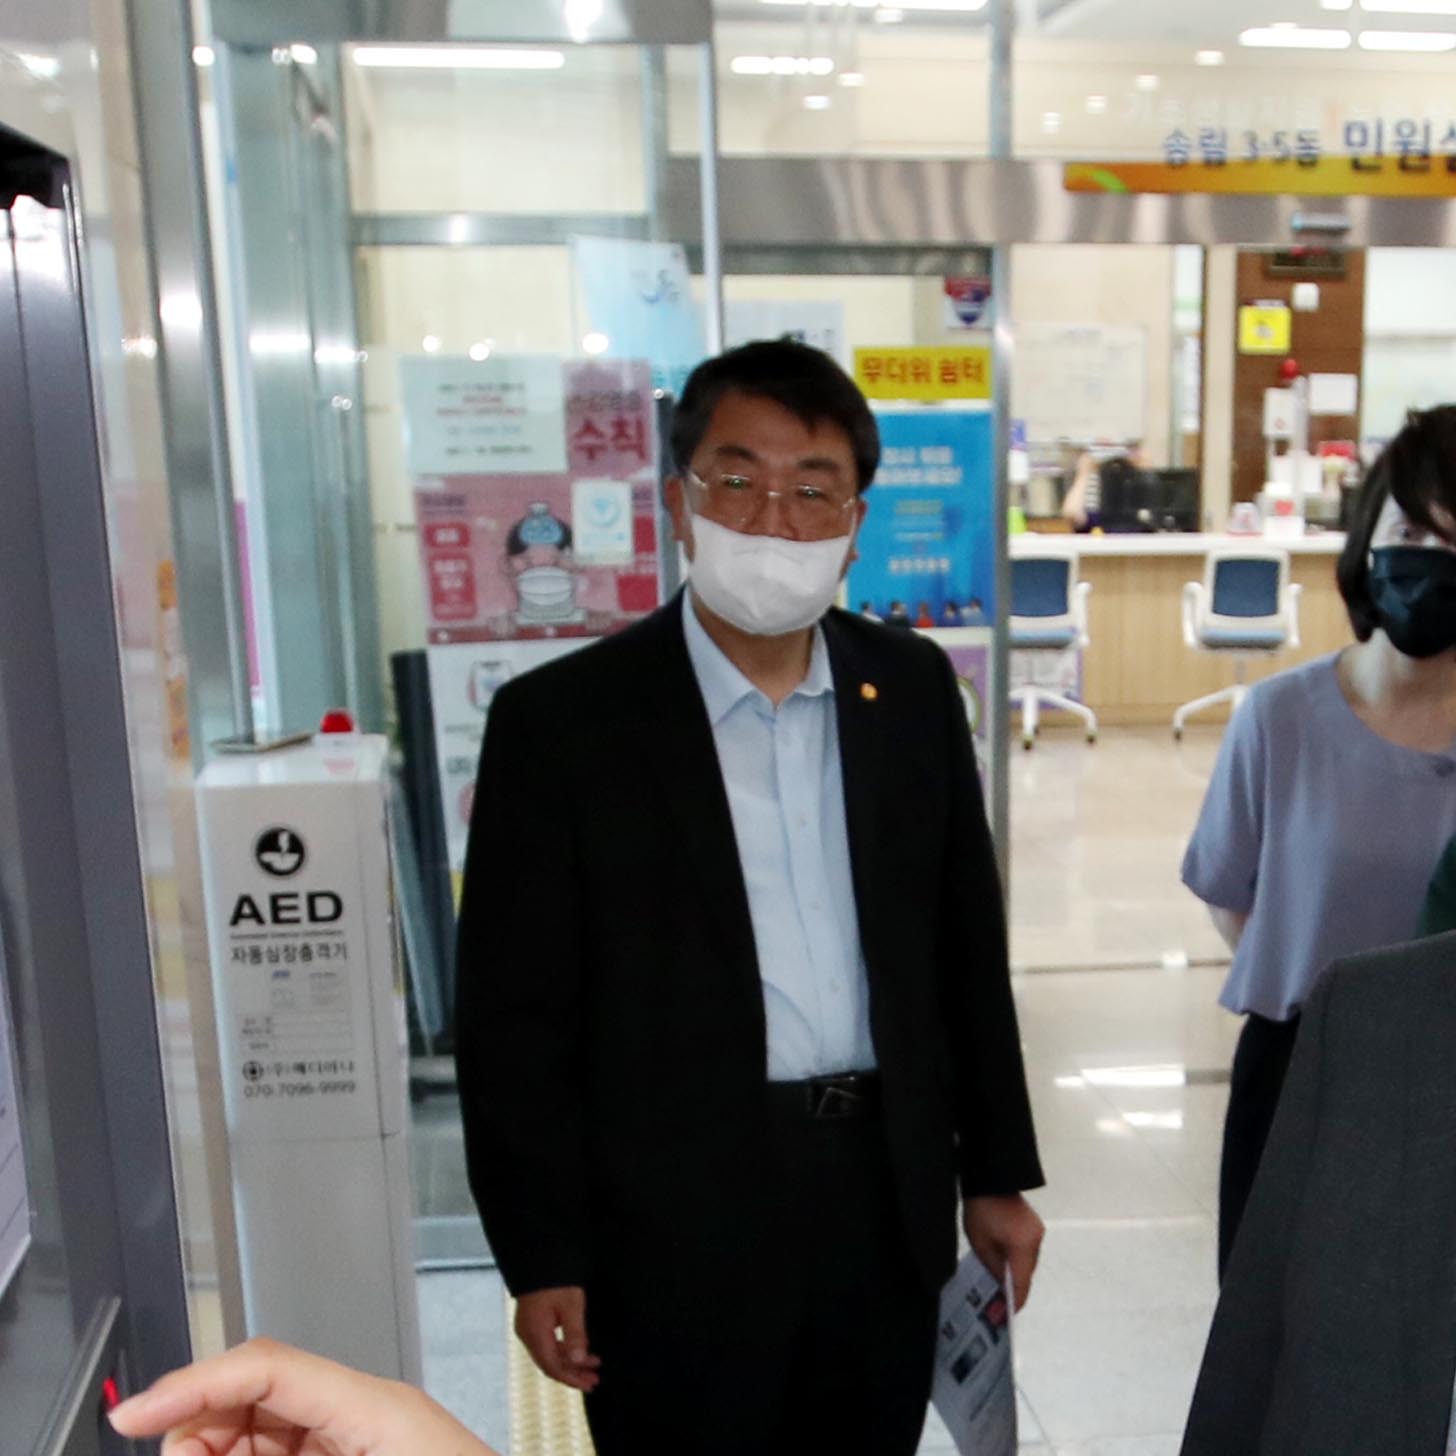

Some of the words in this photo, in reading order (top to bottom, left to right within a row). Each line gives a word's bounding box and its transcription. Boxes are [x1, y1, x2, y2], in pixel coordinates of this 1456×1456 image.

[1163, 127, 1229, 168] 송림
[861, 356, 933, 386] 무더위
[938, 355, 985, 386] 쉼터
[575, 417, 648, 461] 수칙
[229, 890, 343, 926] AED
[231, 941, 348, 966] 자동심장충격기
